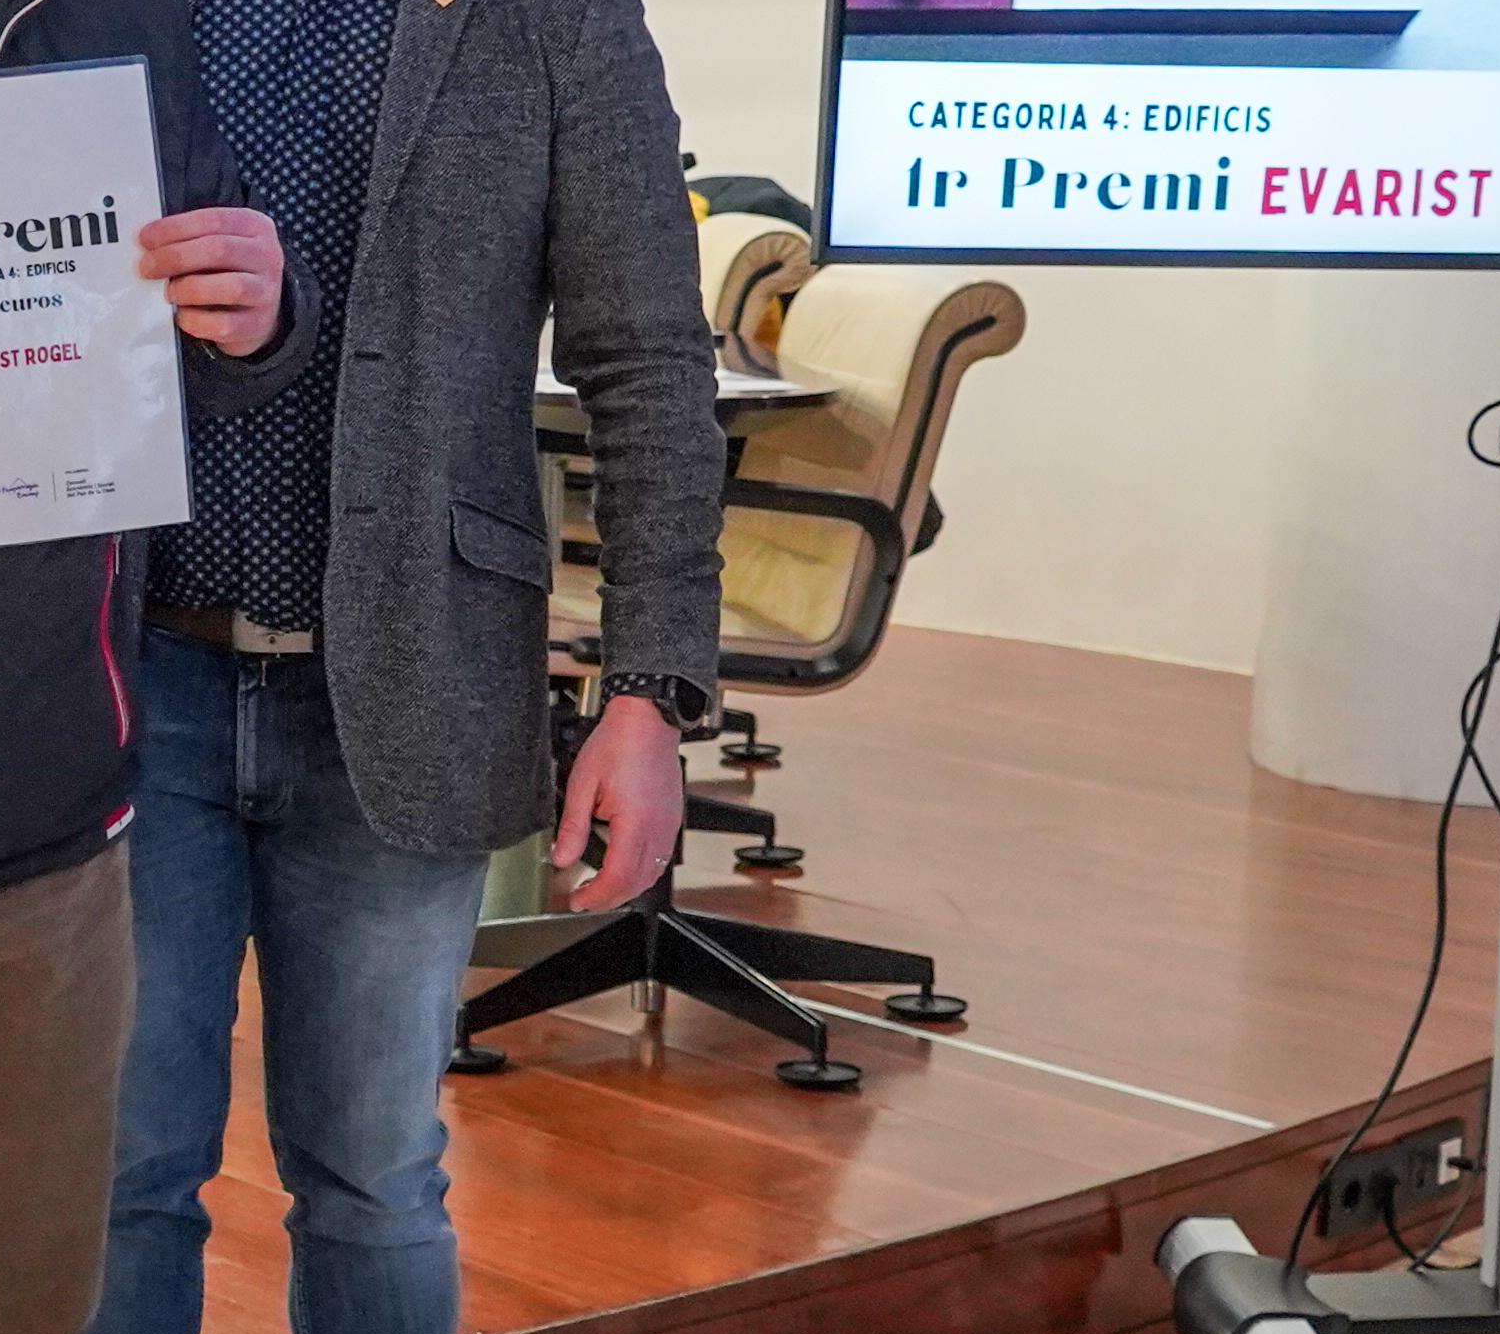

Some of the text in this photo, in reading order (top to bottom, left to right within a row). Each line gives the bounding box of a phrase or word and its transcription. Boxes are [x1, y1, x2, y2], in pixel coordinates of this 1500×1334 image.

[908, 100, 1272, 133] CATEGORIA 4: EDIFICIS
[907, 157, 968, 207] 1r
[1001, 156, 1231, 211] Premi
[1260, 166, 1493, 217] EVARIST
[8, 266, 21, 280] 4:
[26, 260, 77, 278] EDIFICIS
[24, 342, 83, 367] ROGEL
